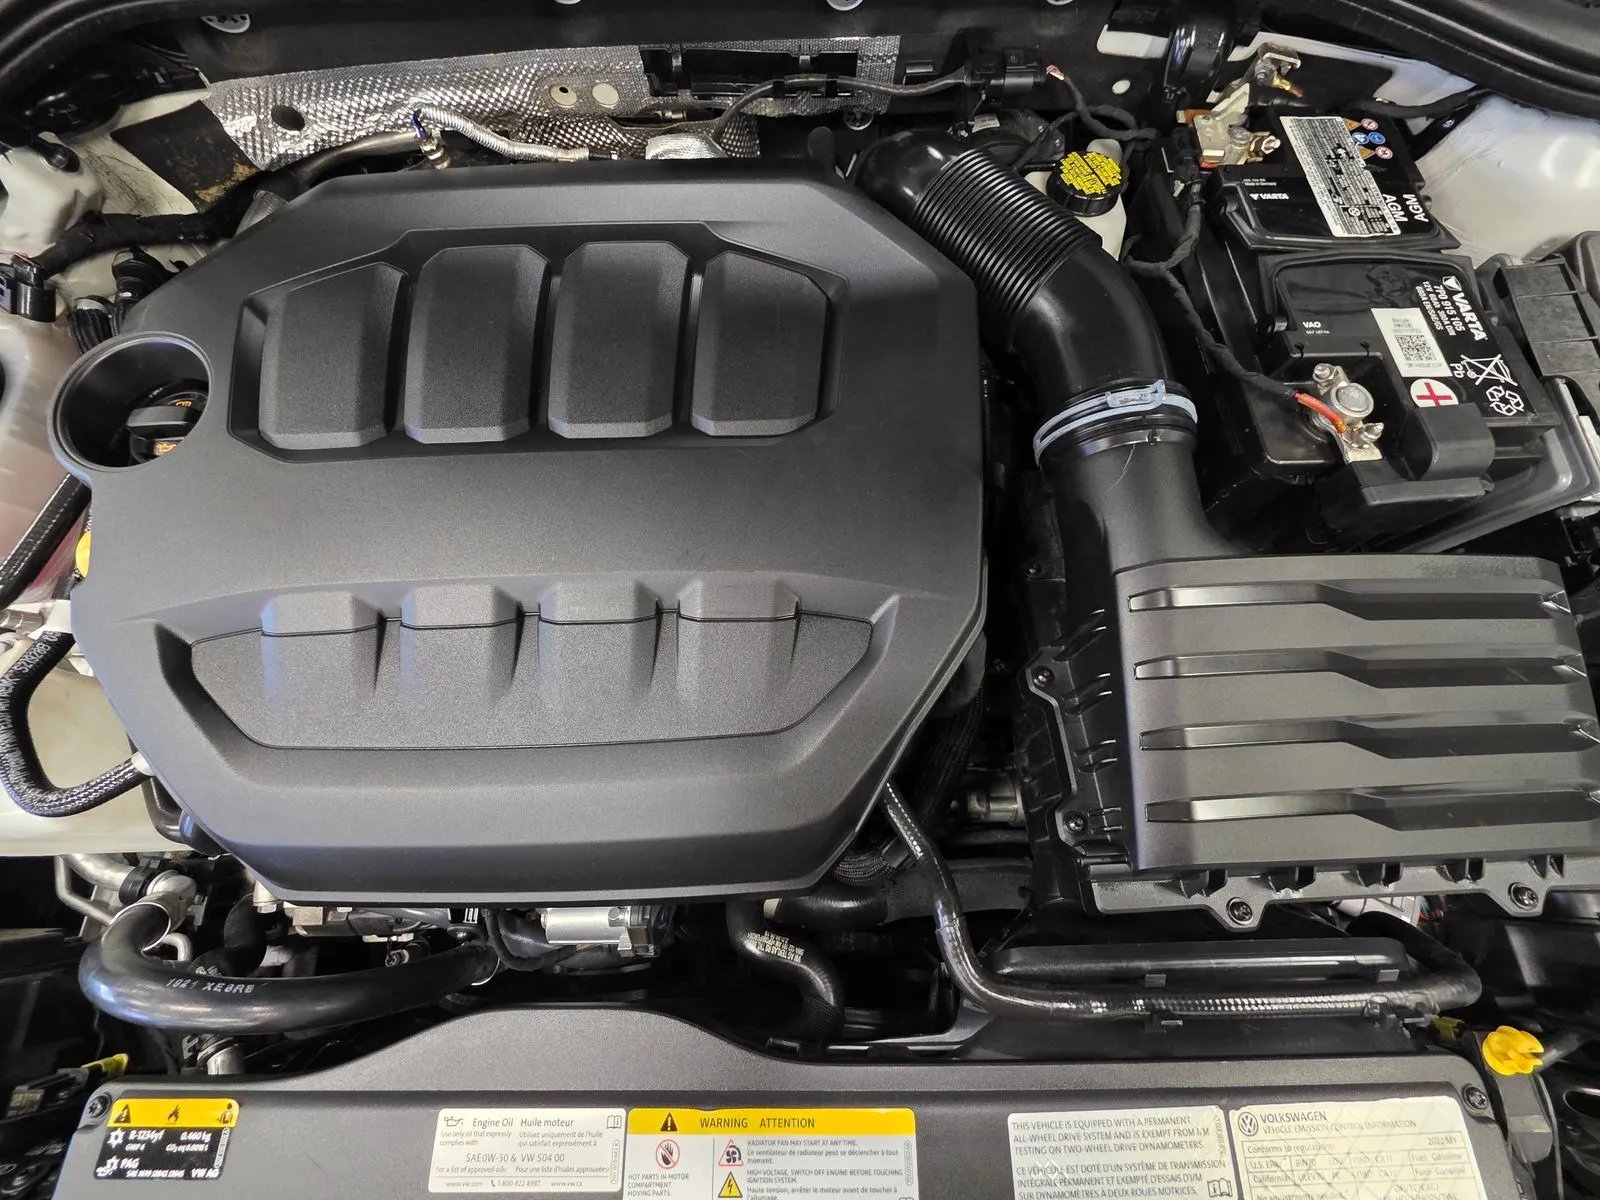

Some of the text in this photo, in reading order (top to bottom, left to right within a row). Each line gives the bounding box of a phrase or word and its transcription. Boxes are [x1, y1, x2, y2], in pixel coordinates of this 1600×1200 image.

[1382, 193, 1408, 222] AGM
[1402, 194, 1429, 222] AGM
[1433, 284, 1466, 331] 7P0 915 105
[1452, 292, 1487, 341] VARTA
[1449, 363, 1466, 379] Pb
[520, 1118, 575, 1127] Huile moteur
[700, 1118, 748, 1128] WARNING
[760, 1117, 815, 1128] ATTENTION
[1260, 1111, 1328, 1123] VOLKSWAGEN
[472, 1117, 514, 1130] Engine Oil
[1012, 1116, 1192, 1131] THIS VEHICLE IS EQUIPPED WITH A PERMANENT
[1262, 1125, 1291, 1134] VEHICLE
[1294, 1123, 1329, 1133] EMISSION
[1365, 1119, 1417, 1129] INFORMATION
[201, 1131, 212, 1143] kg
[452, 1131, 464, 1139] only
[486, 1131, 512, 1139] expressly
[541, 1131, 576, 1139] uniquement
[1013, 1133, 1058, 1142] ALL-WHEEL
[1058, 1132, 1083, 1142] DRIVE
[1083, 1131, 1112, 1141] SYSTEM
[1113, 1130, 1132, 1139] AND
[1133, 1130, 1140, 1138] IS
[1141, 1129, 1171, 1139] EXEMPT
[1173, 1128, 1197, 1137] FROM
[518, 1140, 528, 1148] qui
[1015, 1139, 1204, 1156] TESTING ON TWO-WHEEL DRIVE DYNAMOMETERS.
[1247, 1144, 1282, 1153] Conforms
[510, 1153, 517, 1162] &
[521, 1153, 535, 1162] VW
[537, 1153, 552, 1162] 504
[554, 1153, 565, 1162] 00
[825, 1149, 839, 1157] peut
[120, 1157, 141, 1169] PAG
[1016, 1166, 1027, 1176] CE
[1066, 1164, 1079, 1174] EST
[1102, 1162, 1123, 1172] D'UN
[1157, 1161, 1169, 1170] DE
[1169, 1159, 1226, 1170] TRANSMISSION
[1250, 1160, 1265, 1169] U.S.
[191, 1168, 220, 1178] VW AG
[467, 1166, 495, 1174] approved
[1060, 1176, 1104, 1187] PERMANENT
[1106, 1176, 1115, 1185] ET
[1150, 1173, 1183, 1183] D'ESSAIS
[1253, 1173, 1289, 1183] California
[1018, 1191, 1035, 1200] SUR
[1108, 1188, 1130, 1198] DEUX
[1131, 1187, 1157, 1197] ROUES
